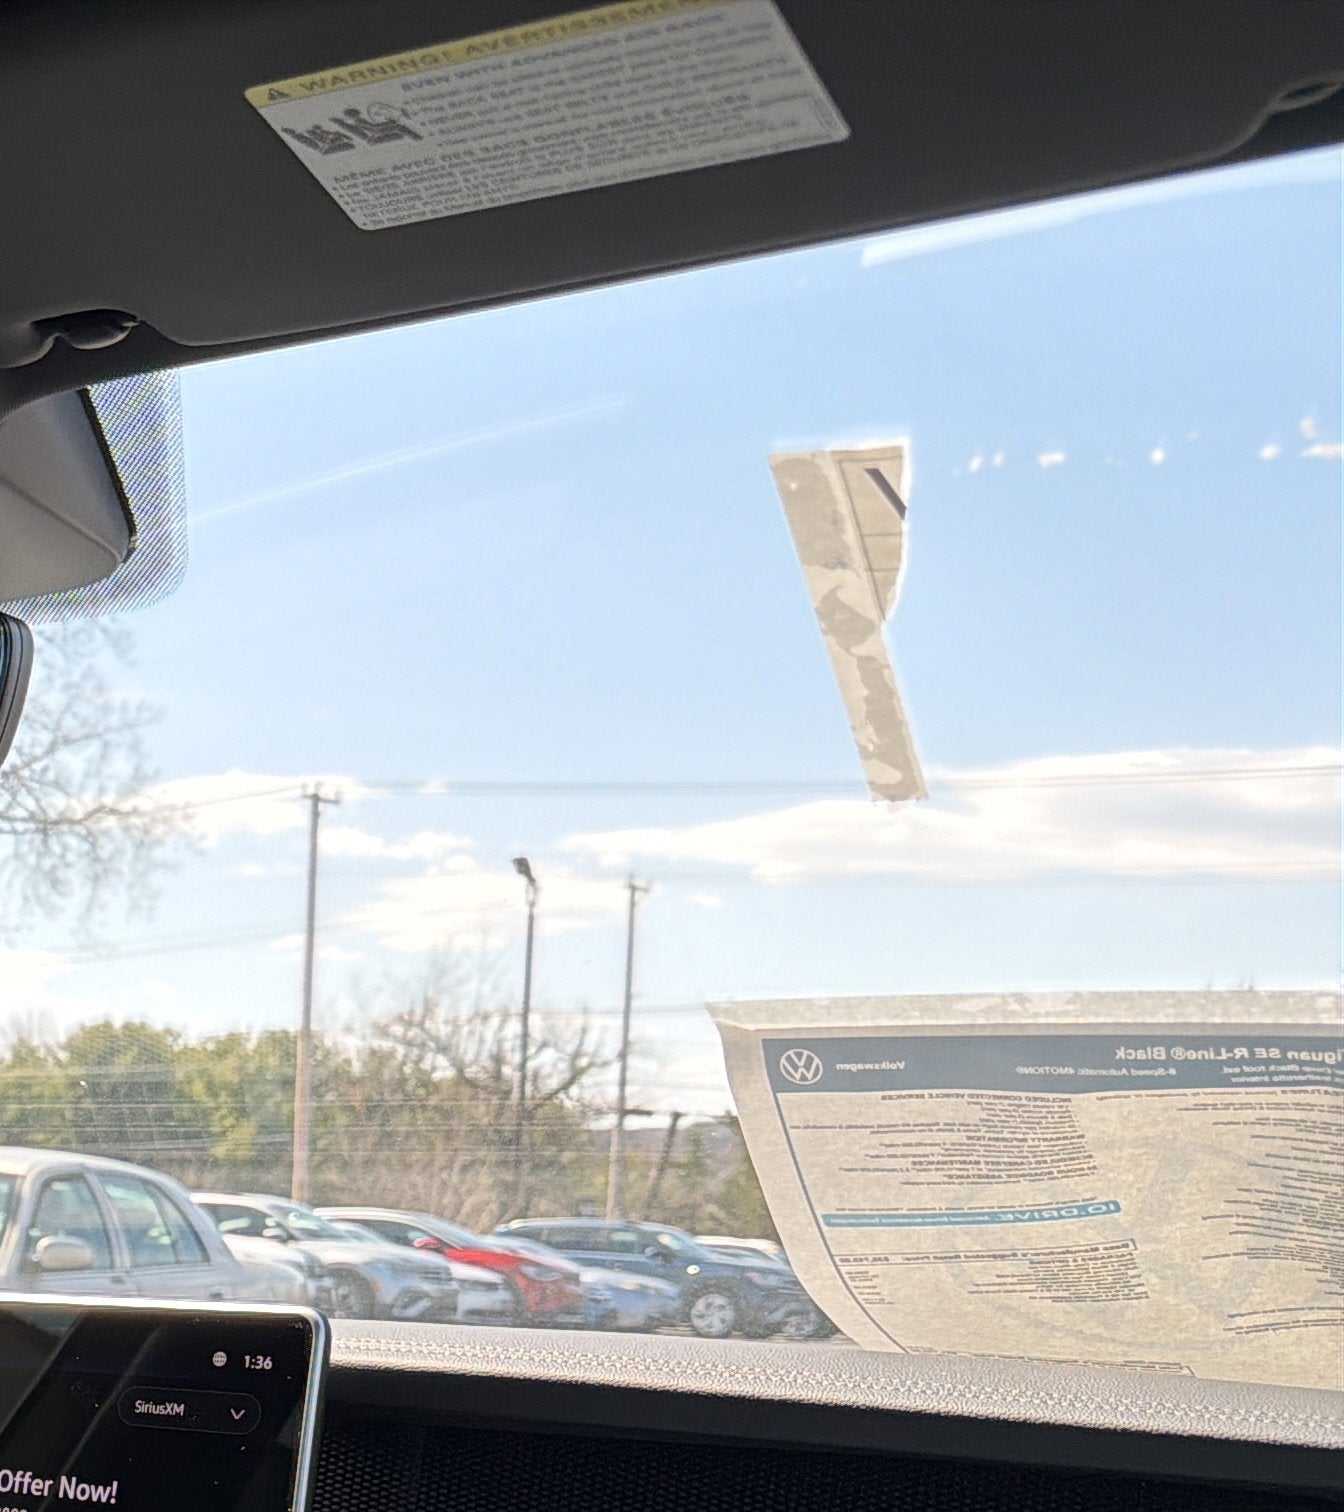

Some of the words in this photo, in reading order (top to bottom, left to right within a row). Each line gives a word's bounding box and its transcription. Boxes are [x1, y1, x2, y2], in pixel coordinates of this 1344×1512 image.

[244, 1355, 273, 1370] 1:36
[134, 1400, 185, 1417] SiriusXM
[59, 1475, 119, 1505] Now!
